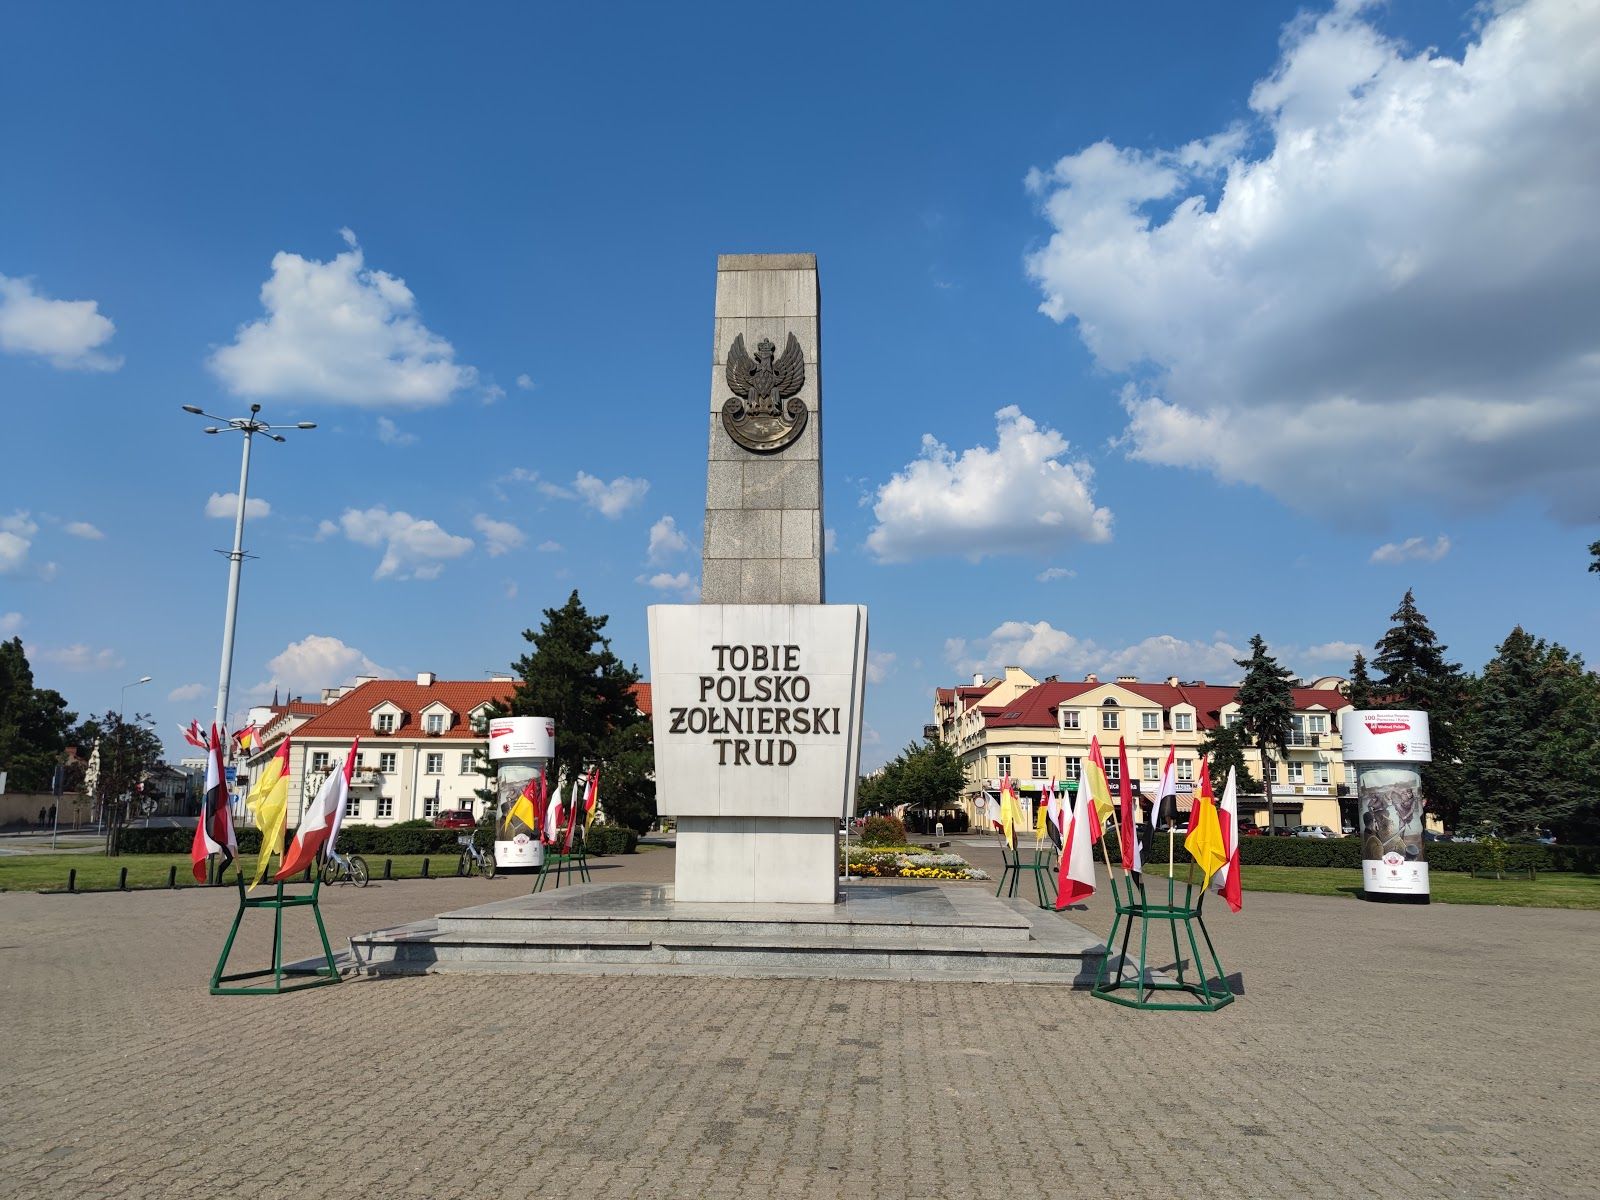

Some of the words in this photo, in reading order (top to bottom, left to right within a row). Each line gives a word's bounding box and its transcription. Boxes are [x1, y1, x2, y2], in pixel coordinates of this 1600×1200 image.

[711, 645, 800, 671] TOBIE
[699, 675, 810, 702] POLSKO
[712, 739, 797, 766] TRUD
